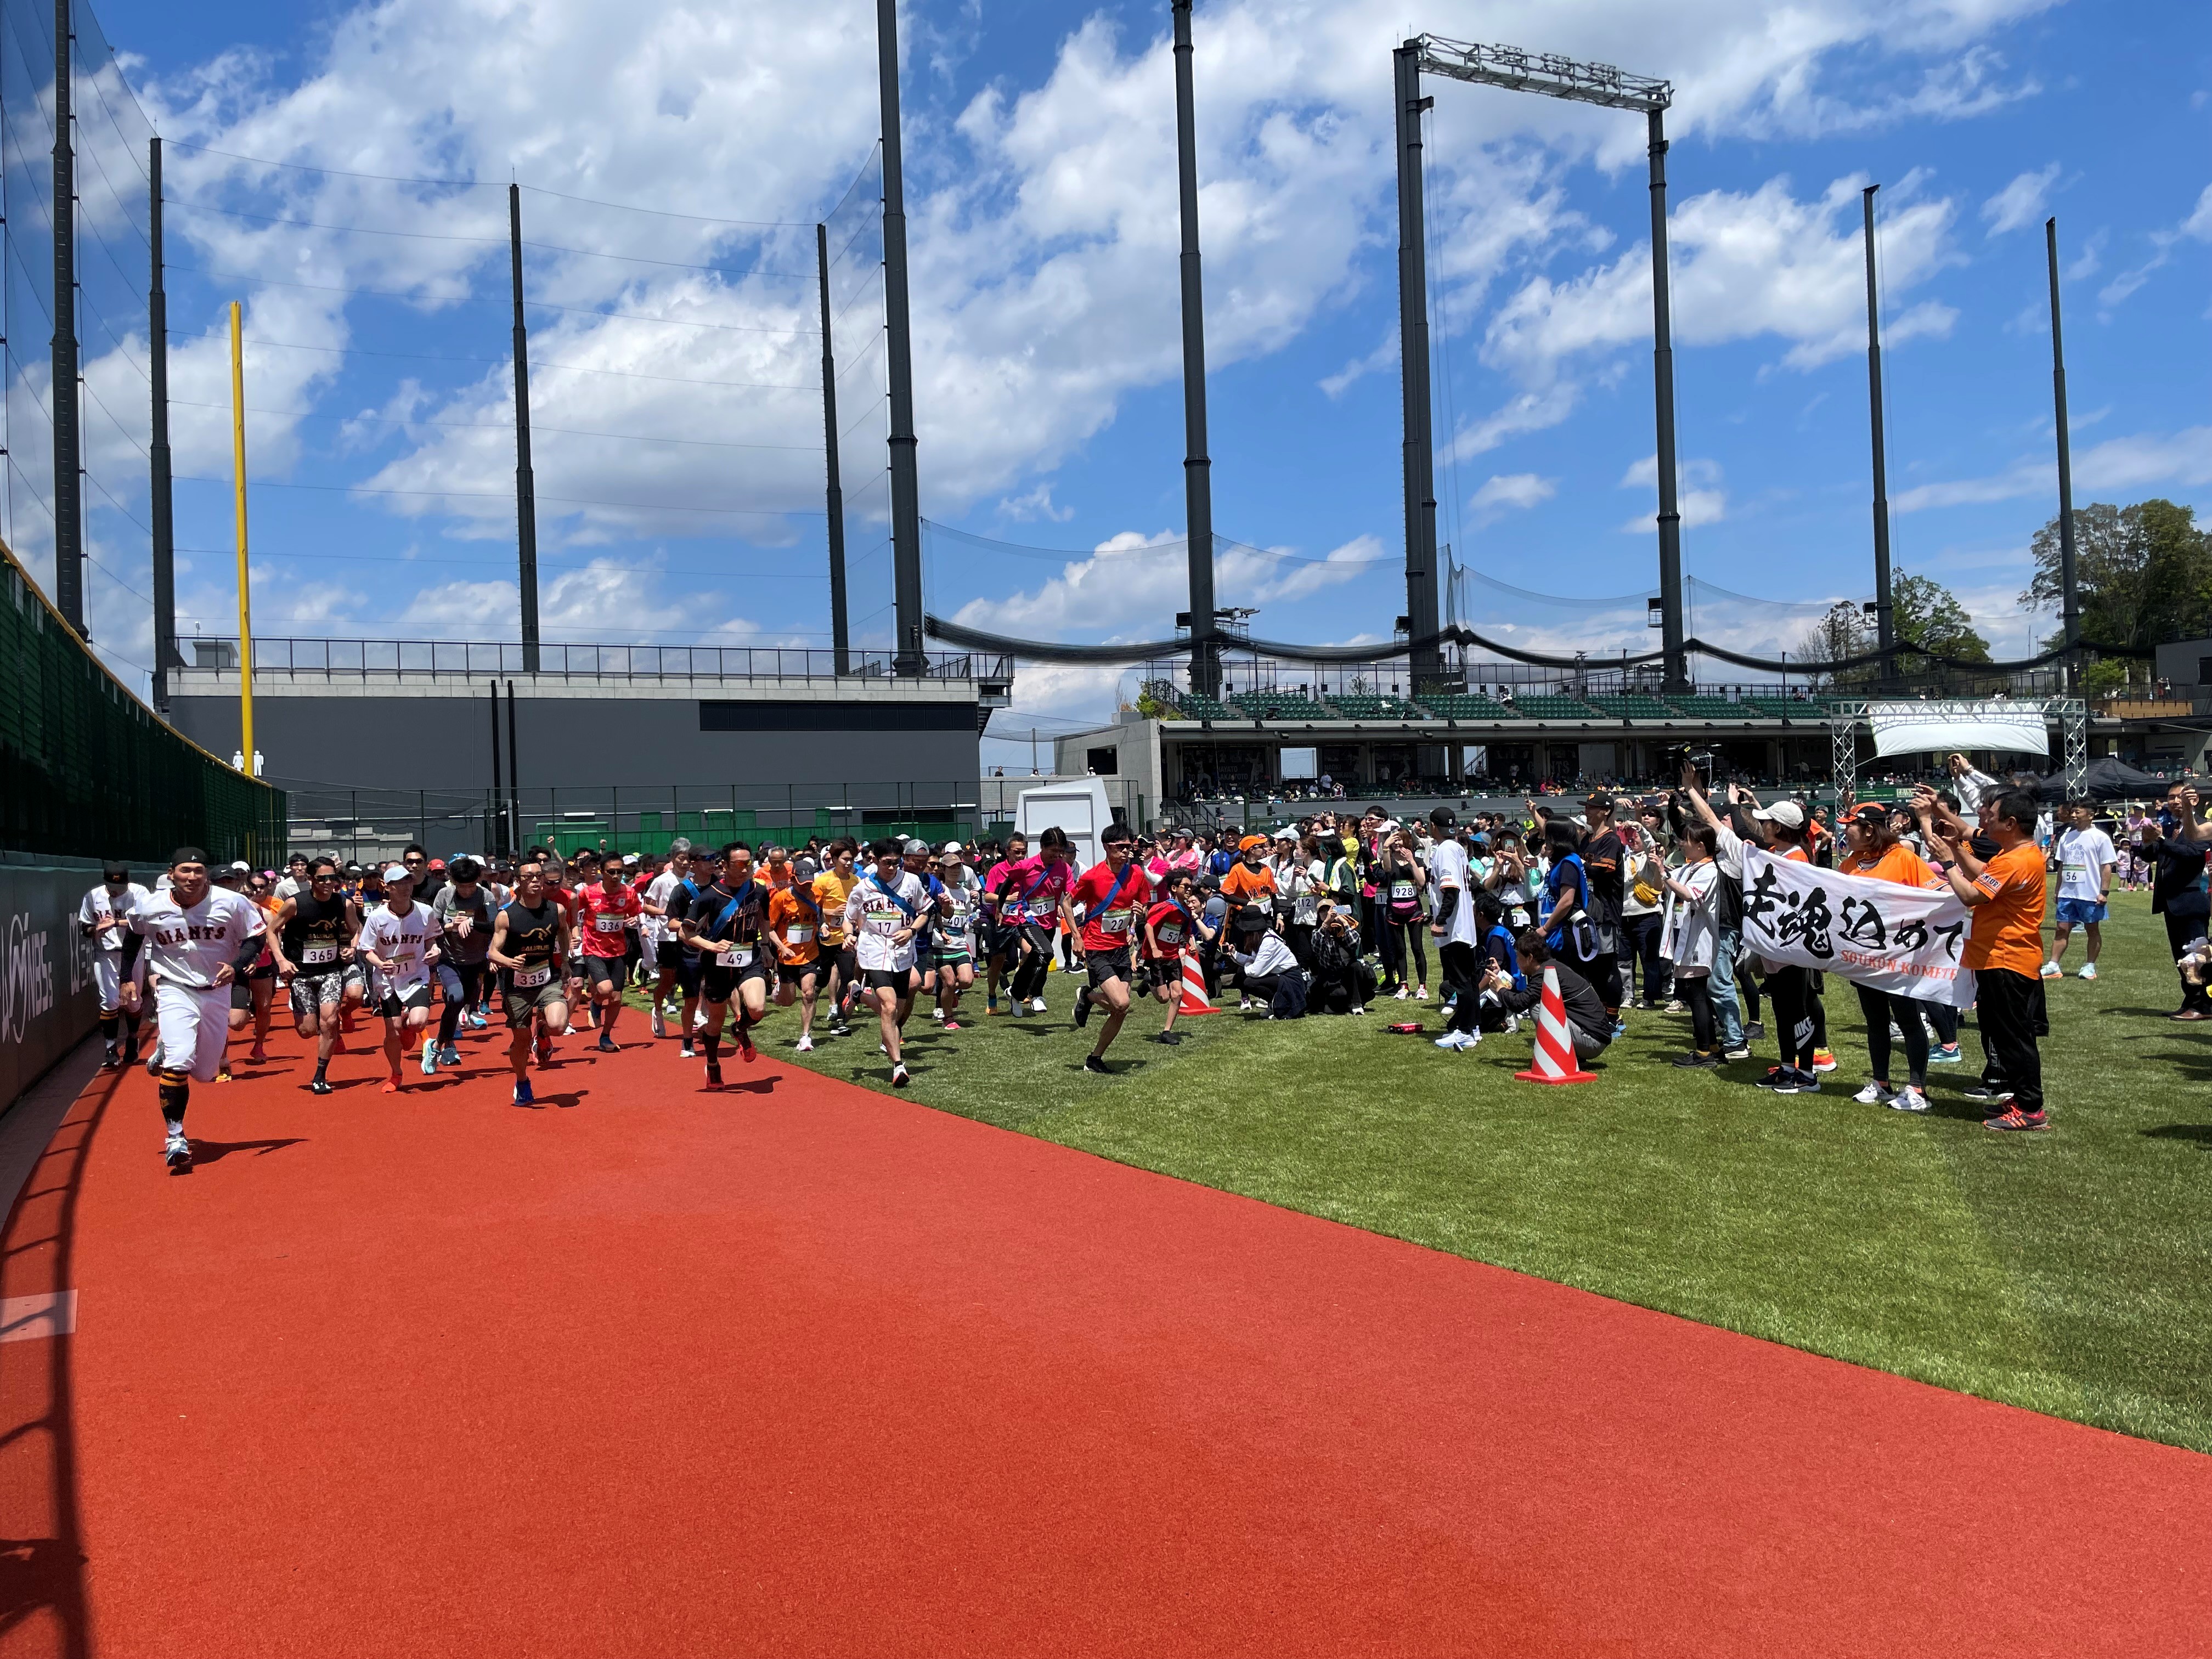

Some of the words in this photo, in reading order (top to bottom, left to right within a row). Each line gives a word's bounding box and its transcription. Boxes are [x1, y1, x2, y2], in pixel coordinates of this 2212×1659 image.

[2066, 872, 2076, 881] 56
[1396, 887, 1413, 896] 928
[1037, 903, 1048, 914] 73
[600, 921, 619, 931] 336
[947, 917, 963, 926] 401
[1110, 919, 1124, 930] 22
[878, 922, 891, 933] 17
[156, 927, 226, 945] GIANTS
[380, 934, 423, 946] GIANTS
[800, 932, 804, 942] 1
[1166, 932, 1178, 942] 52
[310, 950, 332, 961] 365
[727, 953, 742, 964] 49
[1841, 950, 1897, 972] SOUKON
[396, 962, 409, 974] 71
[520, 972, 545, 985] 335
